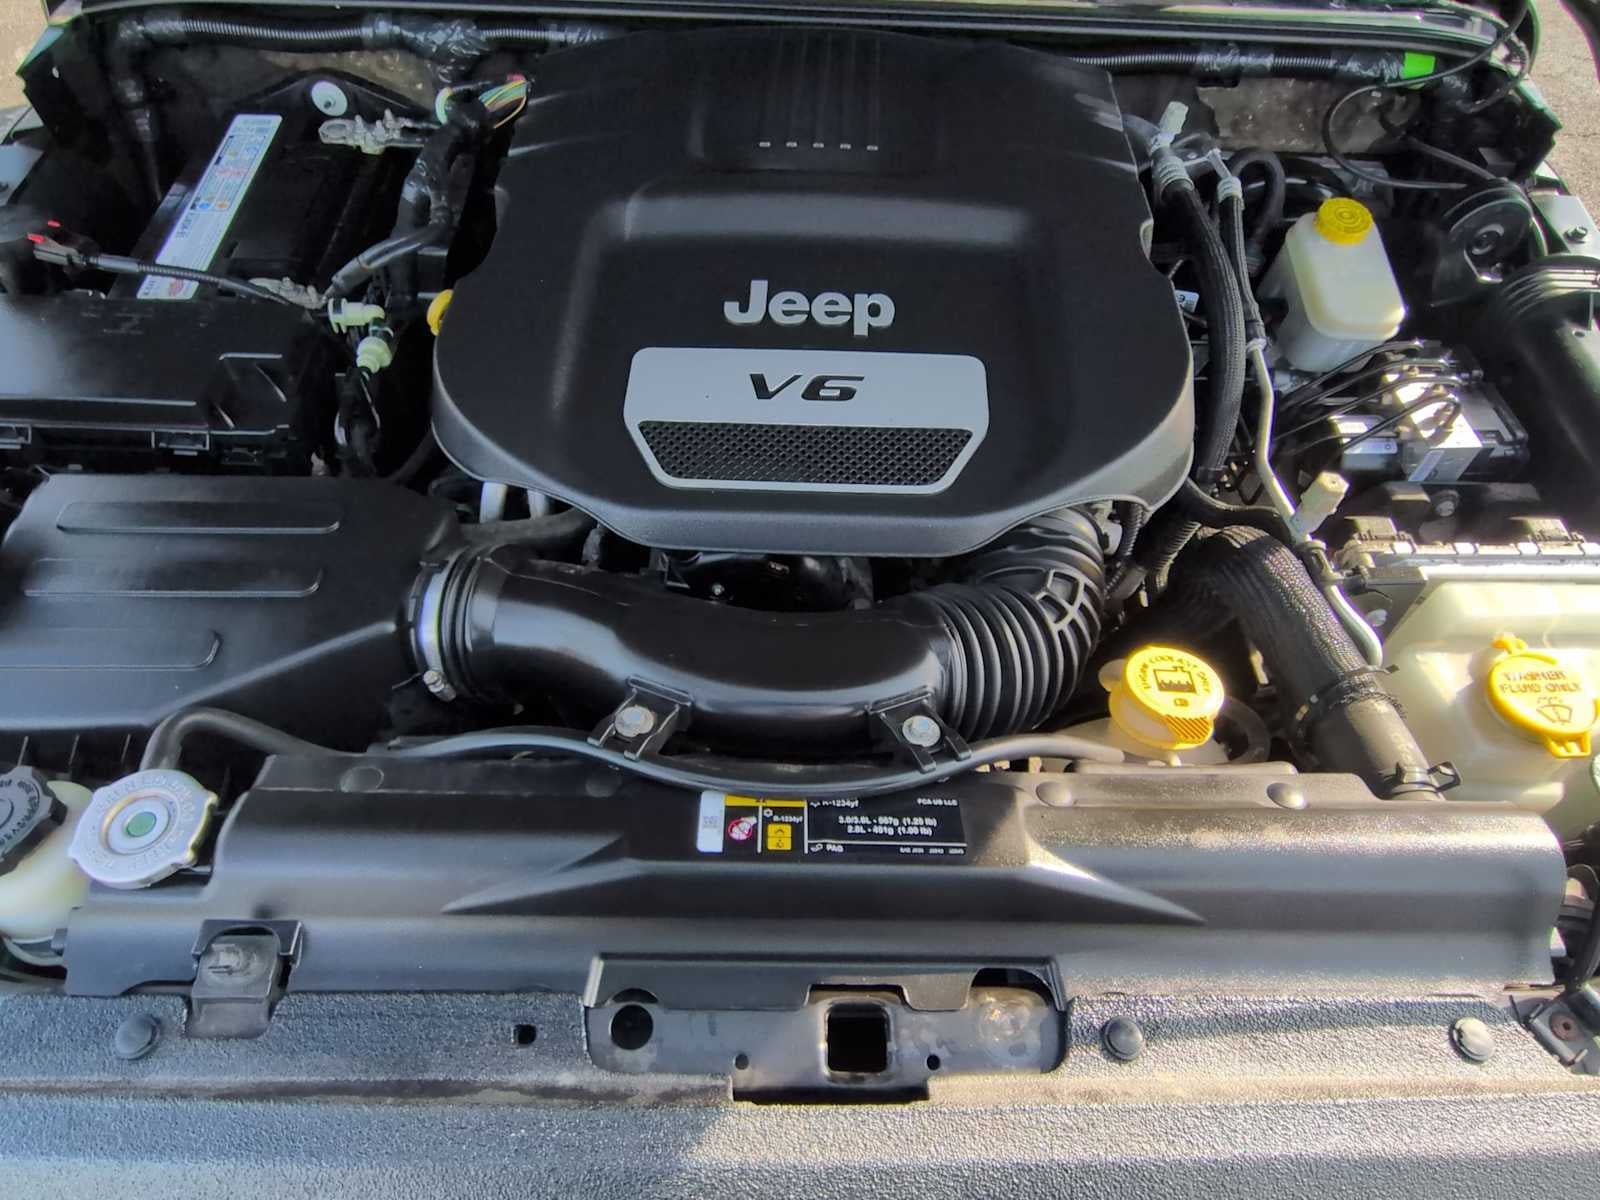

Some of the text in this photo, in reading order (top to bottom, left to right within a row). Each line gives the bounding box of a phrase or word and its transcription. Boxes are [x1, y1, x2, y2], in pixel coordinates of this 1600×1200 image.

[723, 279, 896, 337] Jeep
[749, 373, 865, 402] V6
[1499, 682, 1582, 694] FLUID ONLY
